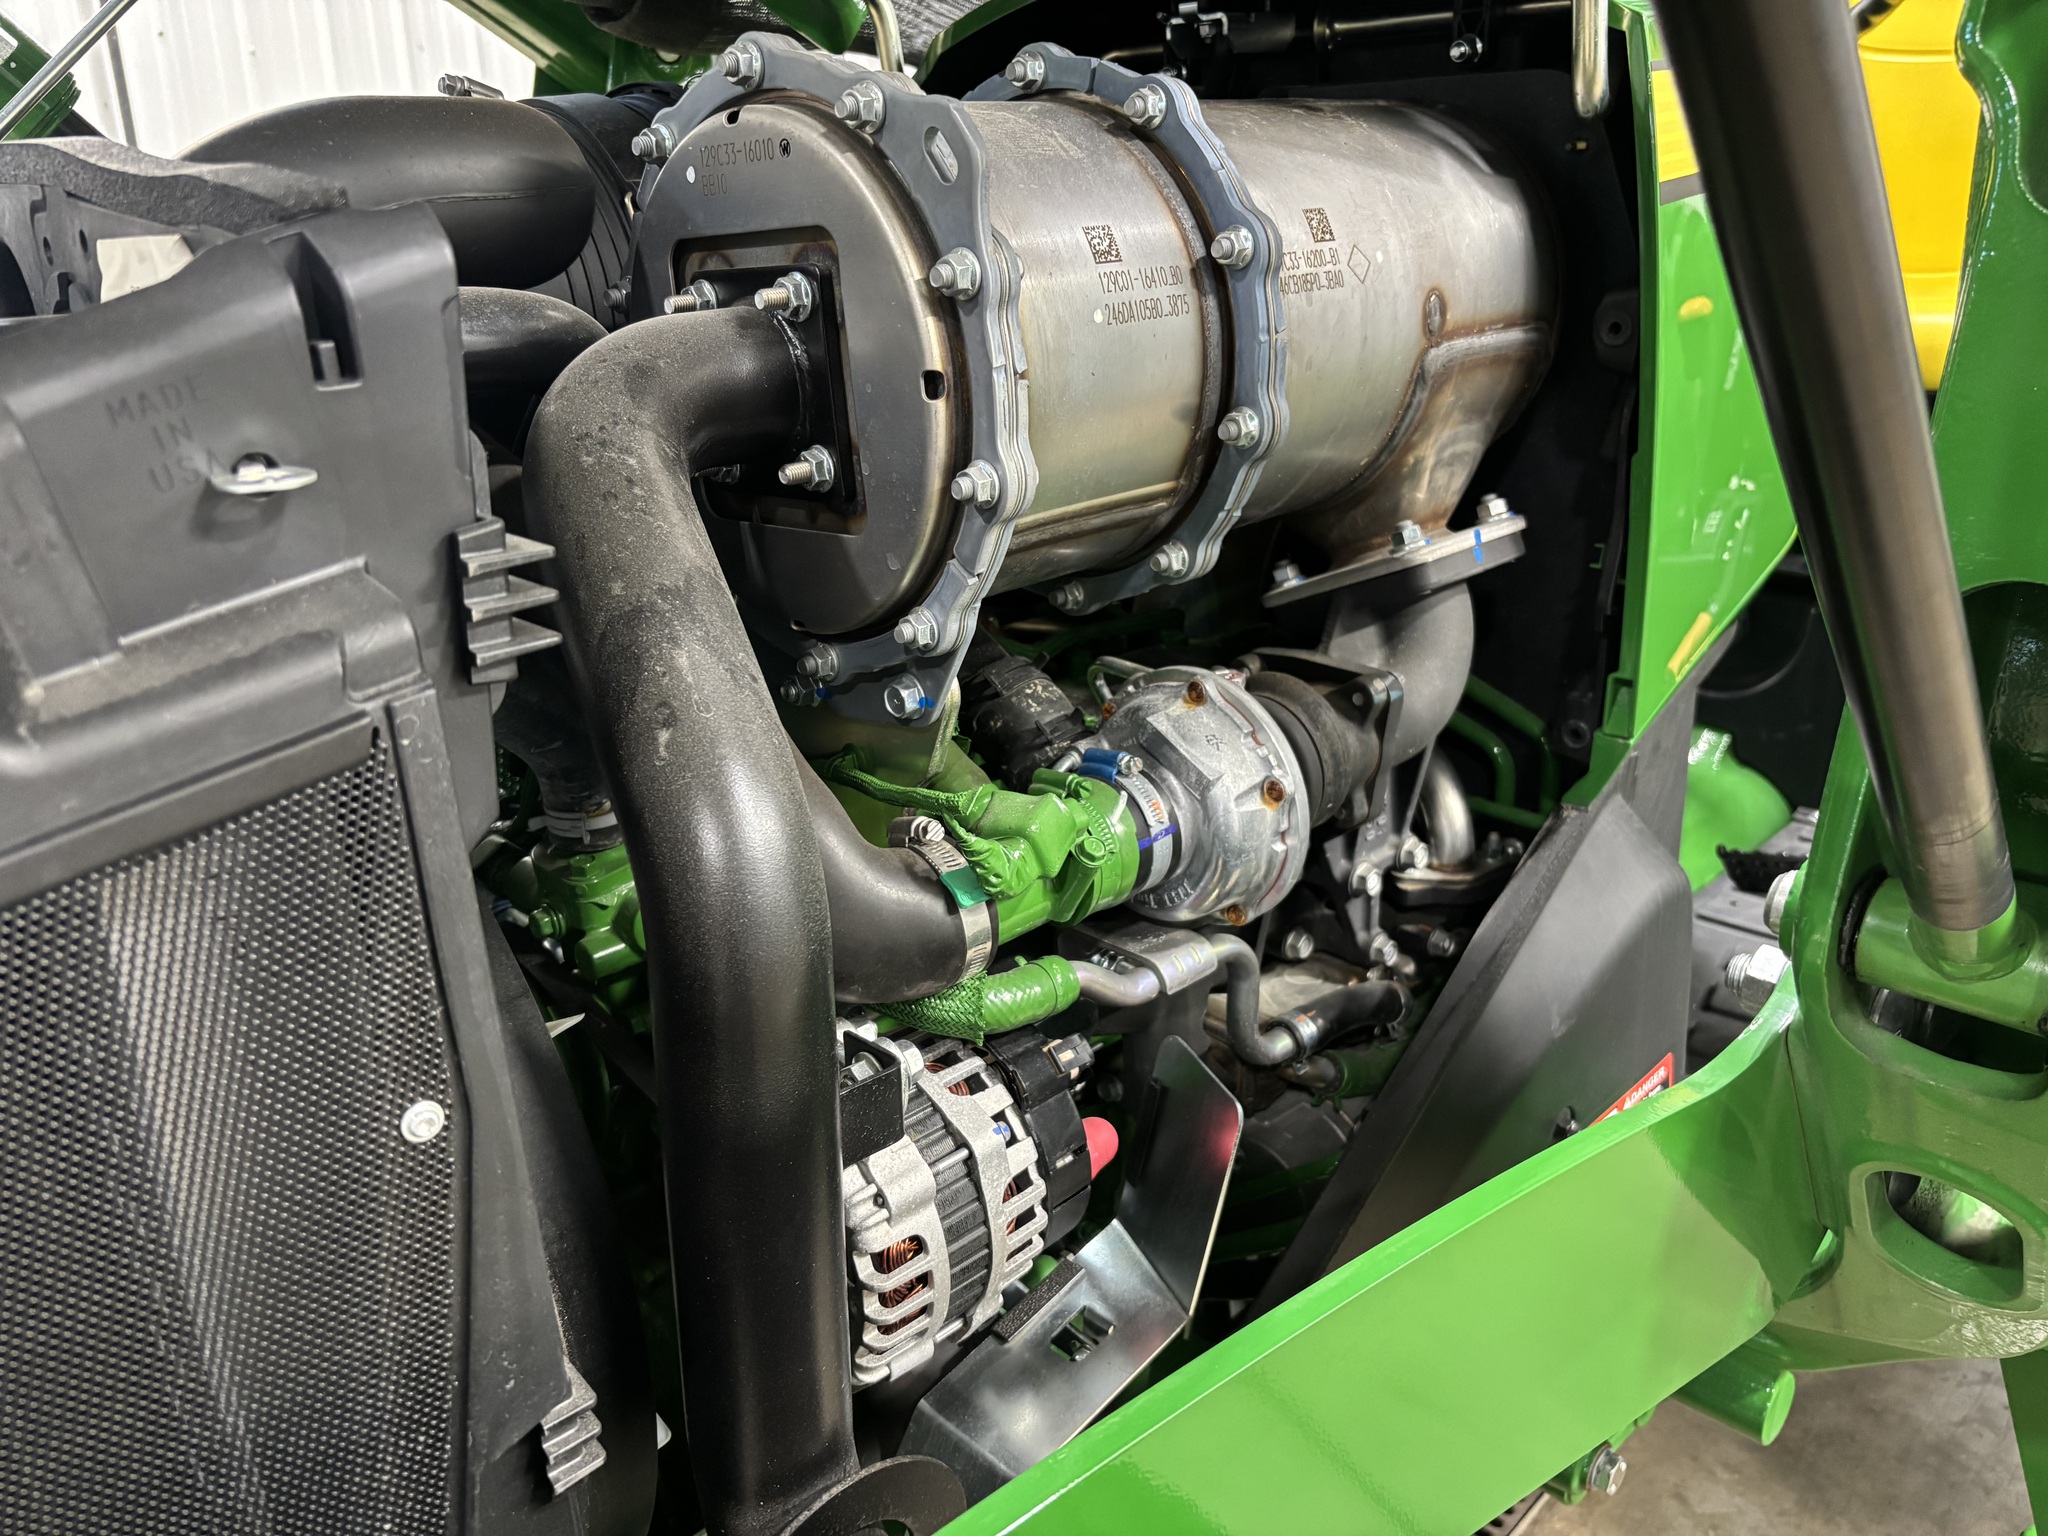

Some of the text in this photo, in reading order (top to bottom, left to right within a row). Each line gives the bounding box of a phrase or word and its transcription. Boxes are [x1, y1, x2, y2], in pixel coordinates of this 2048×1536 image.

[699, 137, 775, 168] 129C33-16010
[1281, 247, 1341, 272] C33-16200_B1
[1098, 265, 1184, 294] 129C01-16410_B0
[104, 375, 208, 429] MADE
[151, 415, 195, 451] IN
[147, 448, 228, 494] USA
[1631, 1066, 1668, 1101] DANGER
